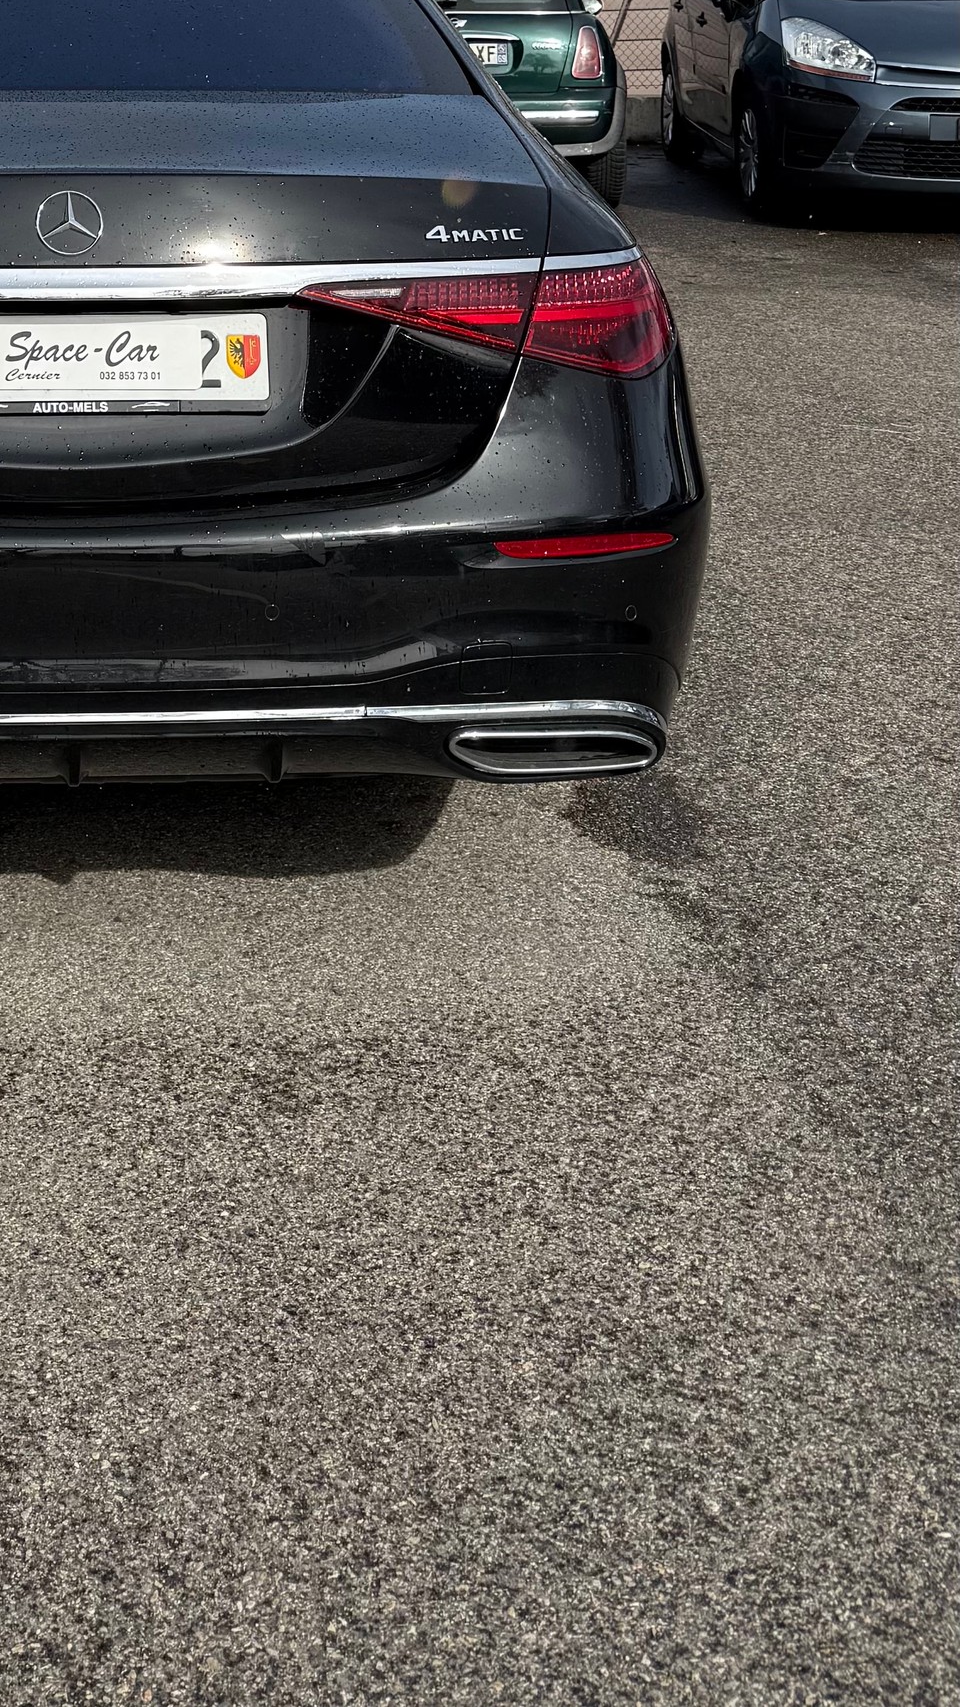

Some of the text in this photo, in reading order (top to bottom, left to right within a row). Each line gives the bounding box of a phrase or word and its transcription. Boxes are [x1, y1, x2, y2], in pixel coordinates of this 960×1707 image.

[425, 225, 524, 243] 4MATIC
[5, 368, 61, 382] Cernier
[99, 371, 161, 381] 032 853 73 01
[32, 401, 109, 413] AUTO-MELS
